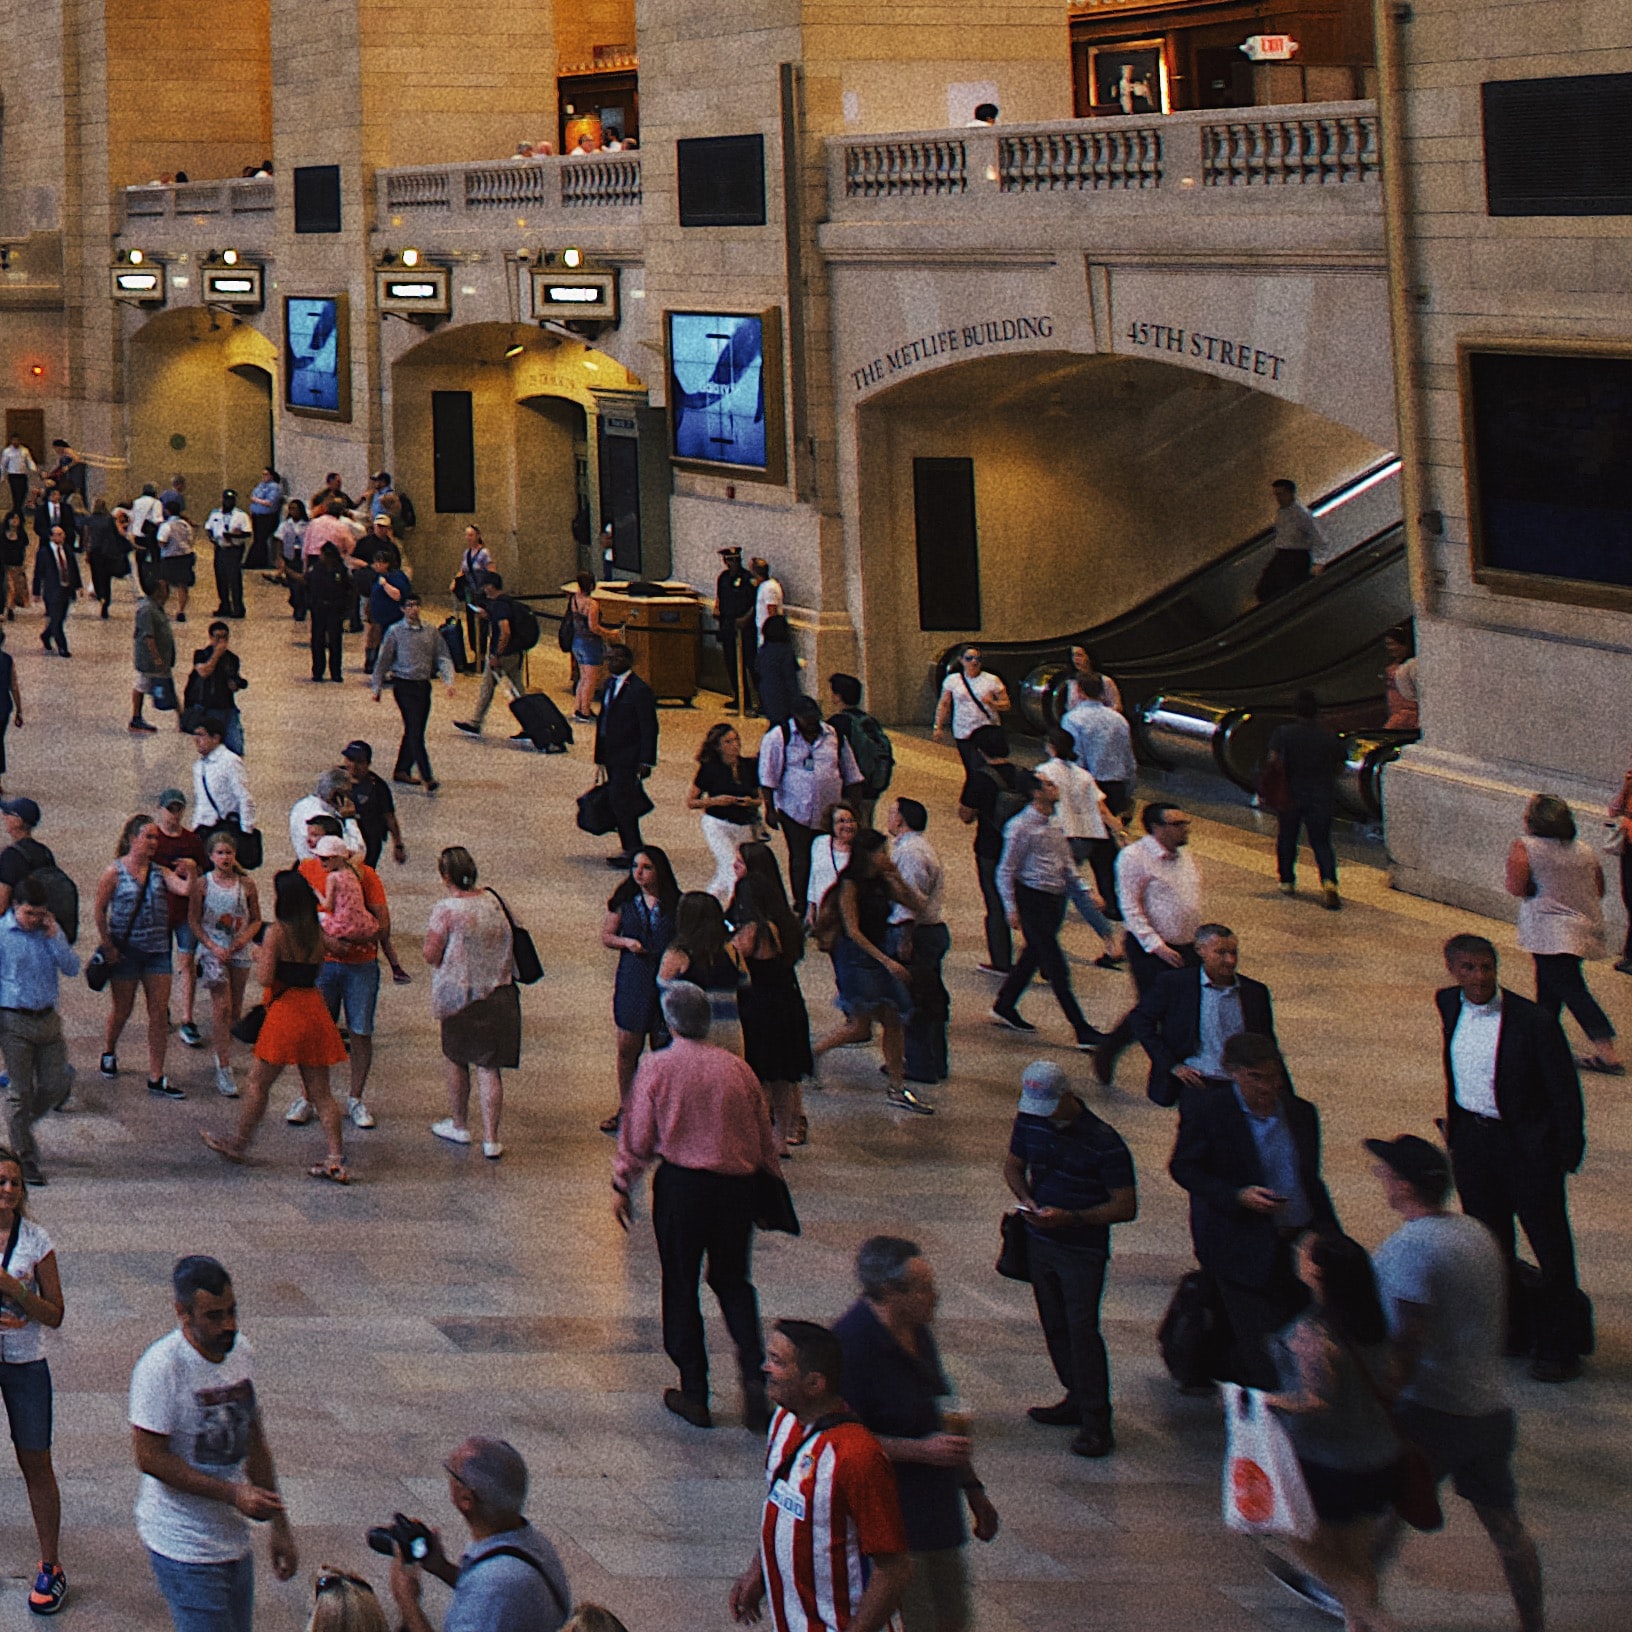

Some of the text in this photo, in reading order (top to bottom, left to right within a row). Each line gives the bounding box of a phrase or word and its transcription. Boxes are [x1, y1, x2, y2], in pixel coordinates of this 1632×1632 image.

[851, 315, 1053, 390] THE METLIFE BUILDING
[1127, 321, 1285, 381] 45TH STREET
